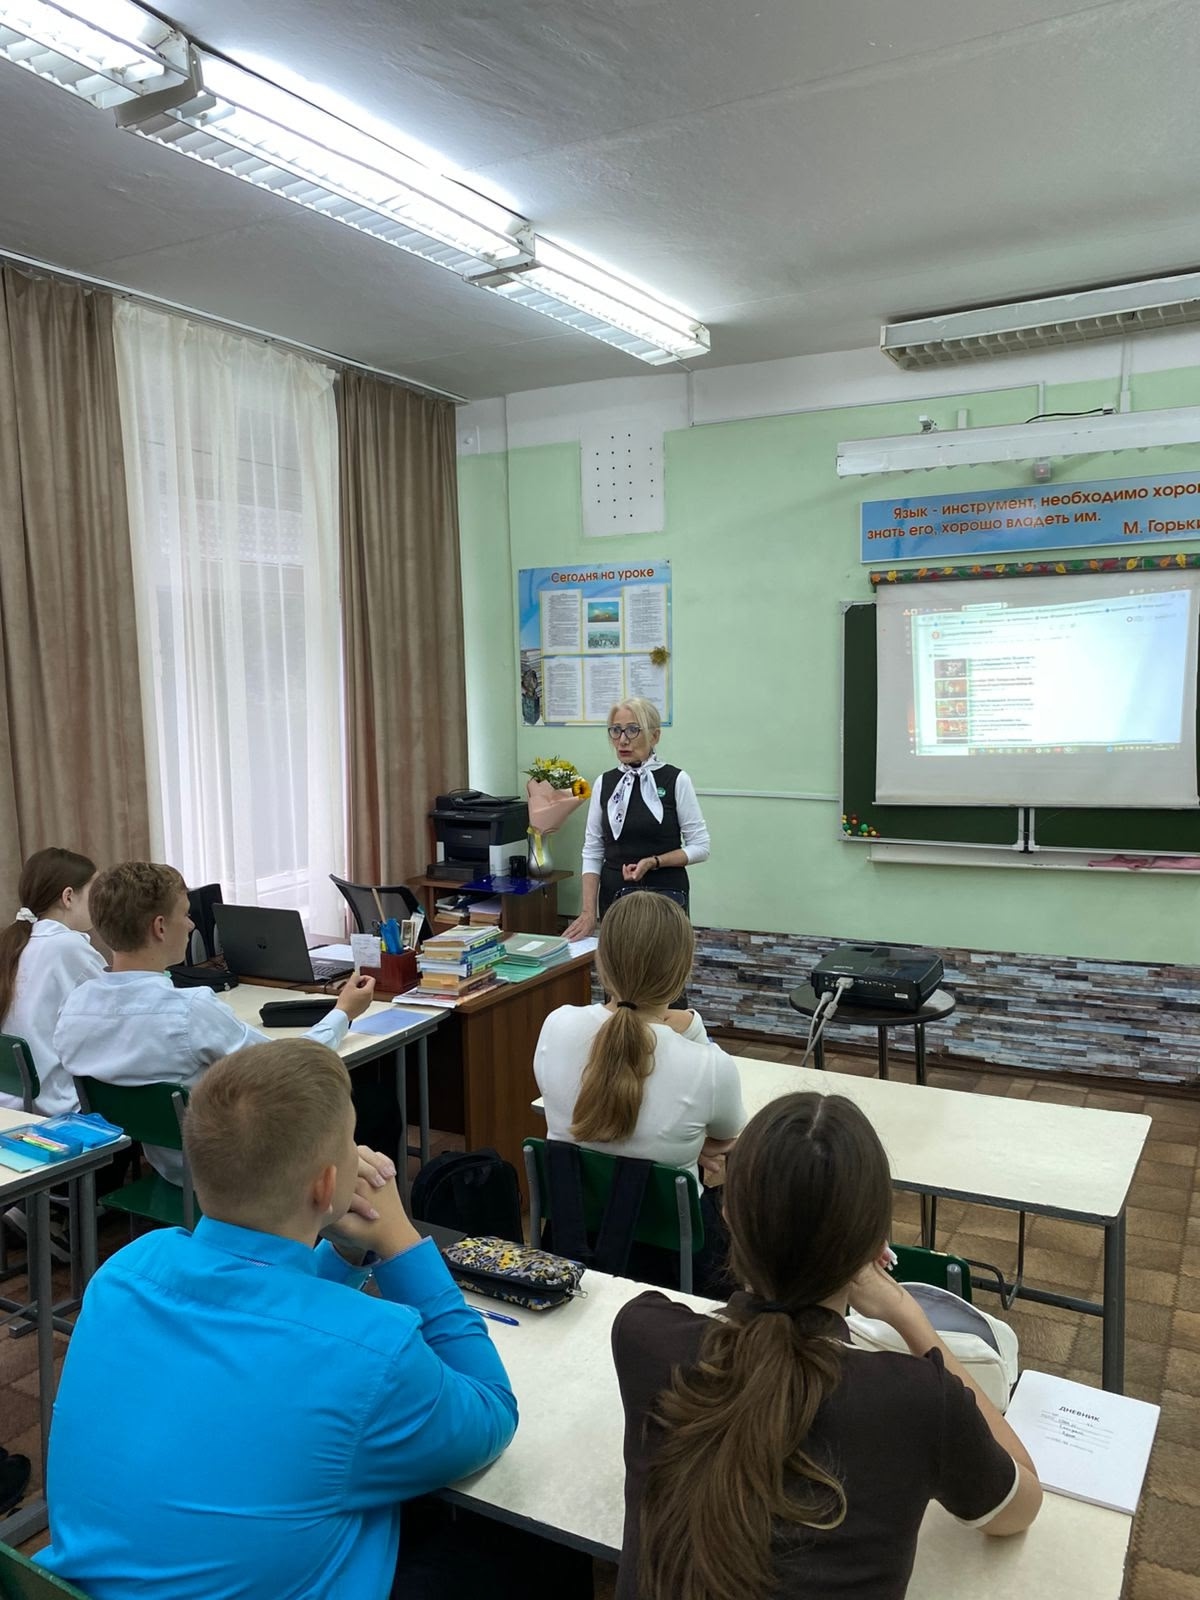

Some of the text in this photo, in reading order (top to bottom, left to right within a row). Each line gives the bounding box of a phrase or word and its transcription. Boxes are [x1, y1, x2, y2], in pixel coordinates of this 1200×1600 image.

[894, 507, 928, 520] Язык
[942, 498, 1037, 515] инструмент,
[1041, 488, 1149, 507] необходимо
[1153, 483, 1200, 498] хоро
[867, 511, 1102, 540] знать его, хорошо владеть им.
[1123, 521, 1143, 535] М.
[551, 568, 654, 583] Сегодня на уроке
[1058, 1406, 1100, 1422] ДНЕВНИК
